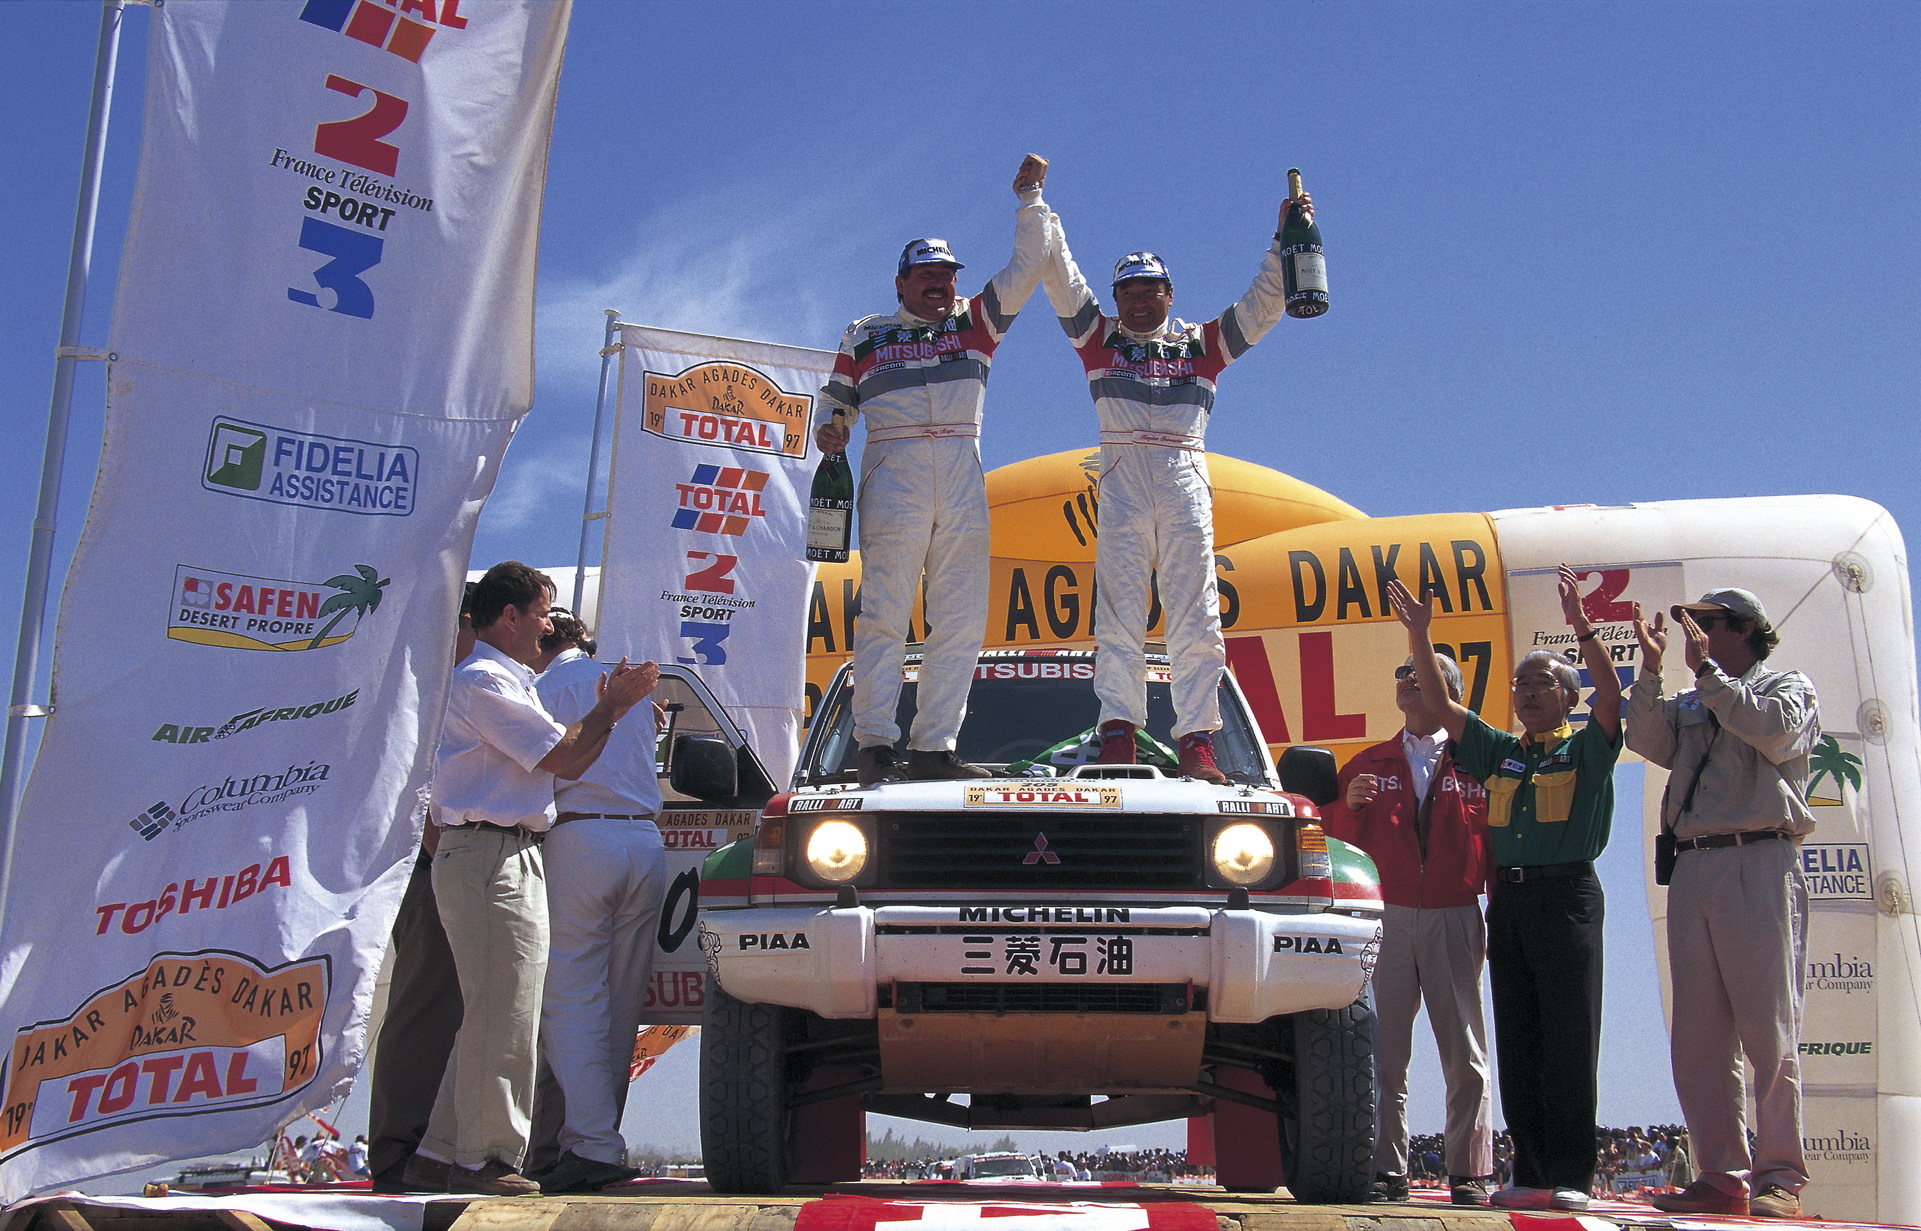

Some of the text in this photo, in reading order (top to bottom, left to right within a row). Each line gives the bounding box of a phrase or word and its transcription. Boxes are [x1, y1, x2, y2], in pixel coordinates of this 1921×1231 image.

[313, 73, 409, 178] 2
[270, 148, 434, 212] France Télévision
[303, 186, 396, 231] SPORT
[287, 216, 384, 320] 3
[650, 368, 803, 418] DAKAR AGADÈS DAKAR
[680, 412, 772, 448] TOTAL
[786, 433, 800, 449] 97
[273, 436, 410, 484] FIDELIA
[269, 472, 408, 510] ASSISTANCE
[675, 483, 766, 517] TOTAL
[685, 550, 738, 595] 2
[1288, 540, 1493, 623] DAKAR
[214, 582, 321, 619] SAFEN
[660, 590, 756, 608] France Télévision
[680, 605, 735, 621] SPORT
[179, 608, 314, 635] DESERT PROPRE
[1532, 631, 1577, 646] Franc
[677, 621, 730, 666] 3
[151, 688, 360, 744] AIR AFRIQUE
[179, 761, 330, 816] Columbia
[795, 799, 861, 811] RALLI ART
[997, 792, 1088, 803] TOTAL
[1104, 796, 1117, 804] 97
[172, 784, 320, 832] Sportswear Company
[666, 813, 751, 826] AGADES DAKAR
[1222, 802, 1285, 814] RALLI ART
[96, 855, 292, 936] TOSHIBA
[959, 907, 1131, 923] MICHELIN
[739, 933, 811, 950] PIAA
[961, 935, 1133, 976] 三菱石油
[1274, 936, 1344, 954] PIAA
[124, 960, 225, 1013] AGADÈS
[231, 977, 314, 1018] DAKAR
[1817, 978, 1874, 994] Company
[67, 1051, 258, 1123] TOTAL
[289, 1046, 312, 1081] 97
[1824, 1151, 1870, 1164] Company
